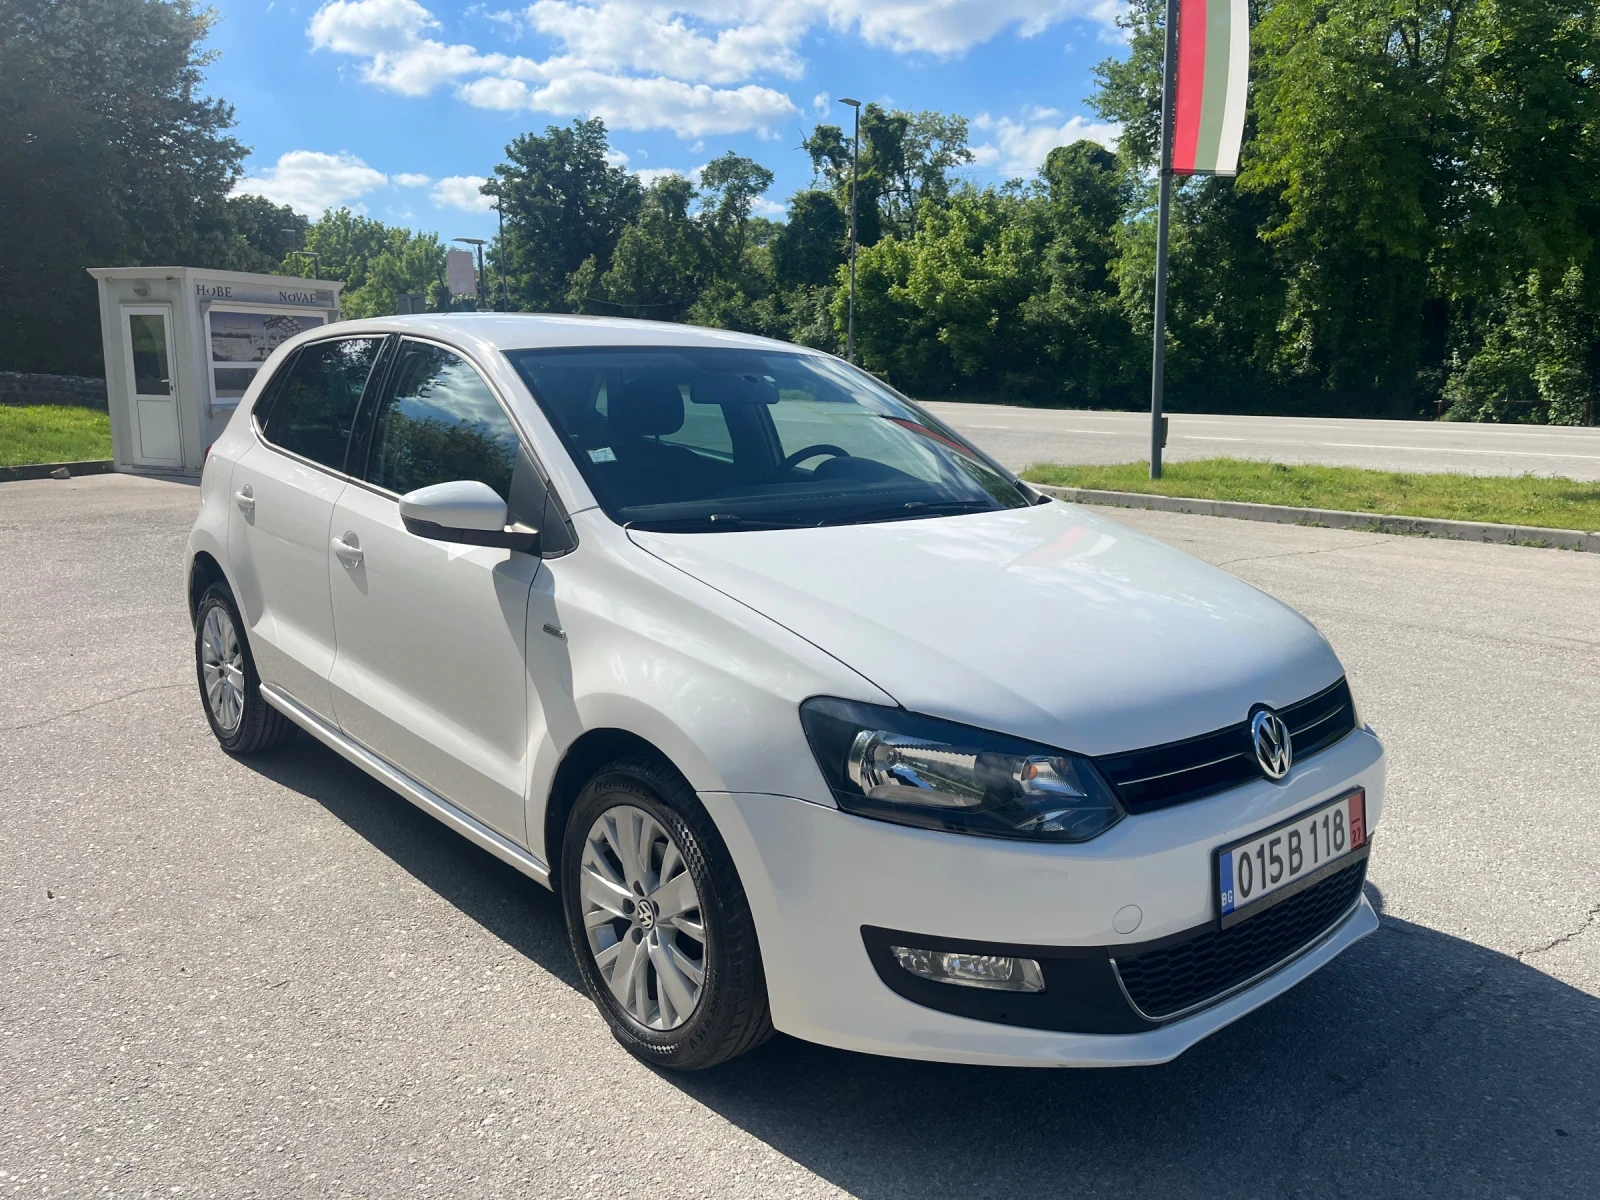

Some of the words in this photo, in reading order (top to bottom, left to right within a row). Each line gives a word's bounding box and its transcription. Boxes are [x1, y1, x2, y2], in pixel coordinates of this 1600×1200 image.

[1252, 711, 1292, 779] VW
[1352, 827, 1361, 844] 27
[1221, 889, 1233, 906] BG
